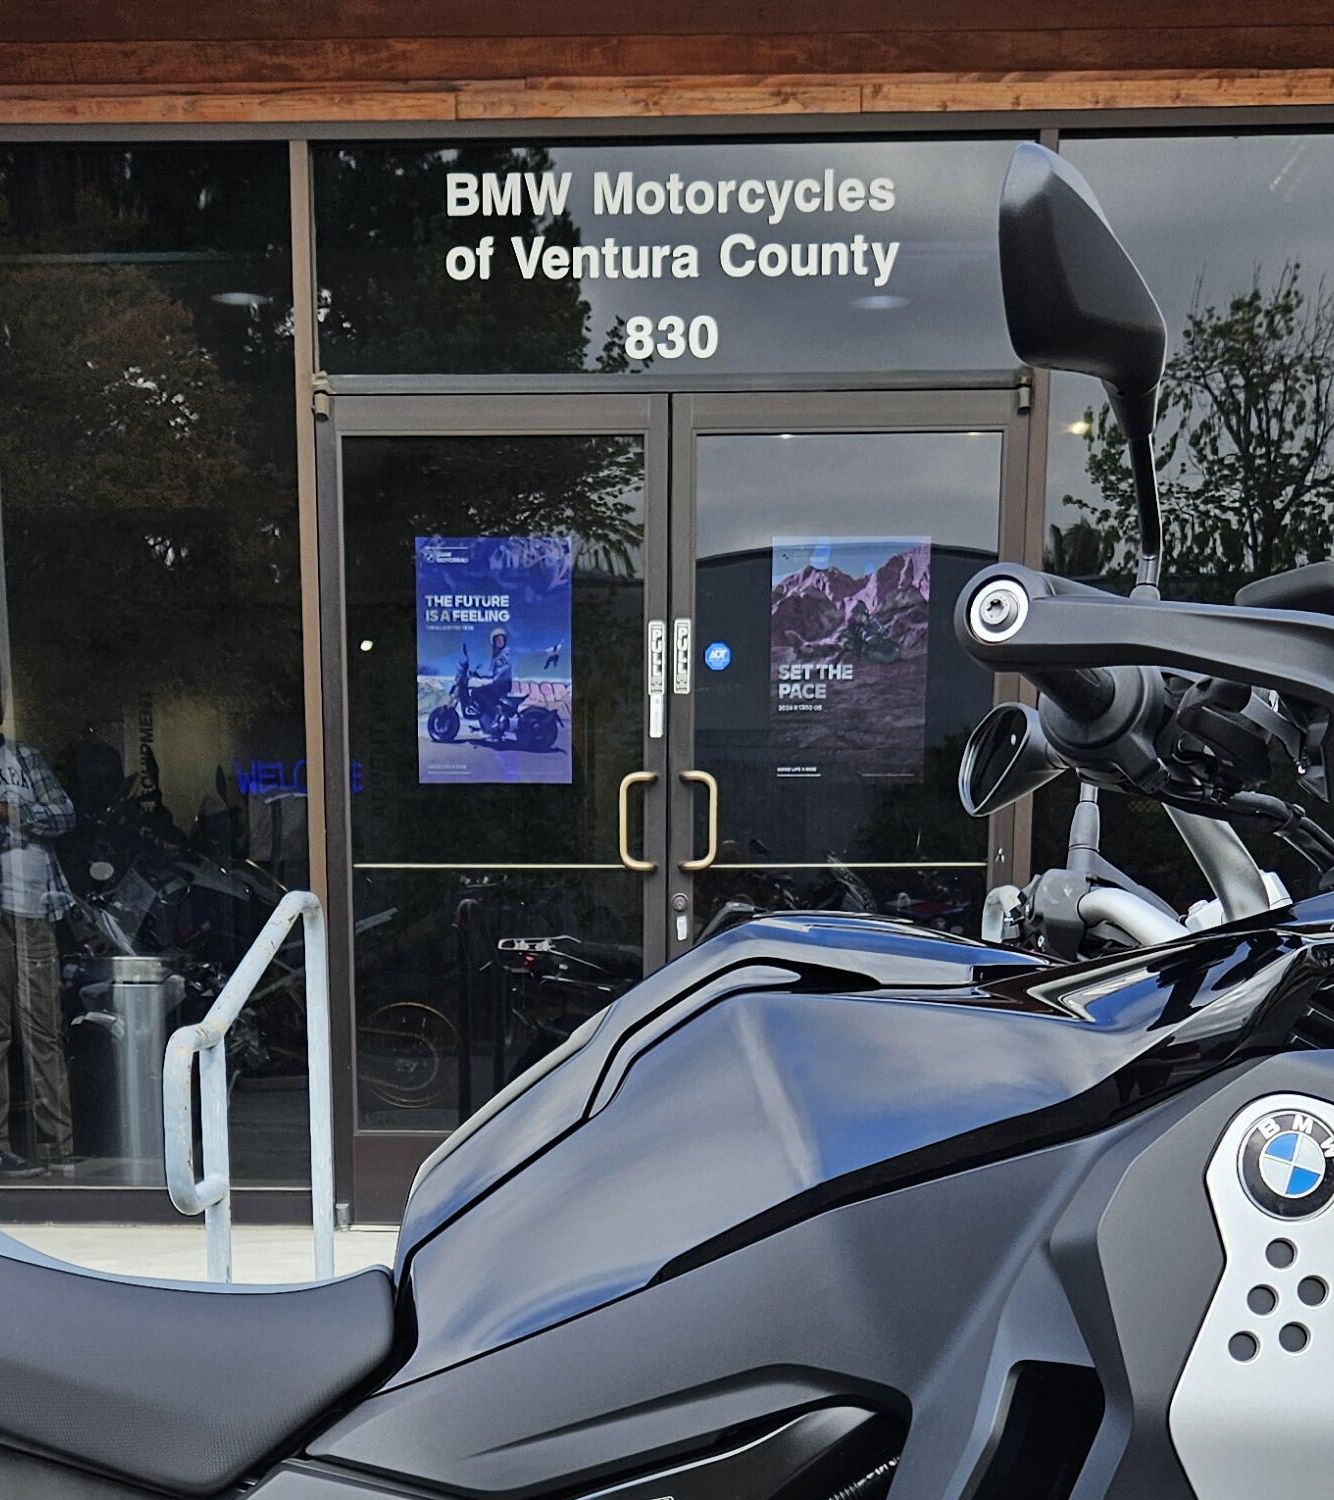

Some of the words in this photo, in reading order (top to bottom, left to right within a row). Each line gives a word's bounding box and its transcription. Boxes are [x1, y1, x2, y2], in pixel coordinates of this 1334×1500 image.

[445, 171, 572, 218] BMW
[593, 168, 897, 225] Motorcycles
[445, 235, 495, 282] of
[511, 235, 700, 281] Ventura
[719, 233, 901, 287] County
[624, 314, 719, 360] 830
[425, 595, 453, 608] THE
[455, 595, 510, 608] FUTURE
[425, 609, 439, 623] IS
[440, 609, 452, 623] A
[452, 609, 511, 623] FEELING
[651, 628, 663, 677] PULL
[677, 626, 688, 675] PULL
[778, 663, 814, 681] SET
[816, 663, 854, 681] THE
[778, 682, 827, 700] PACE
